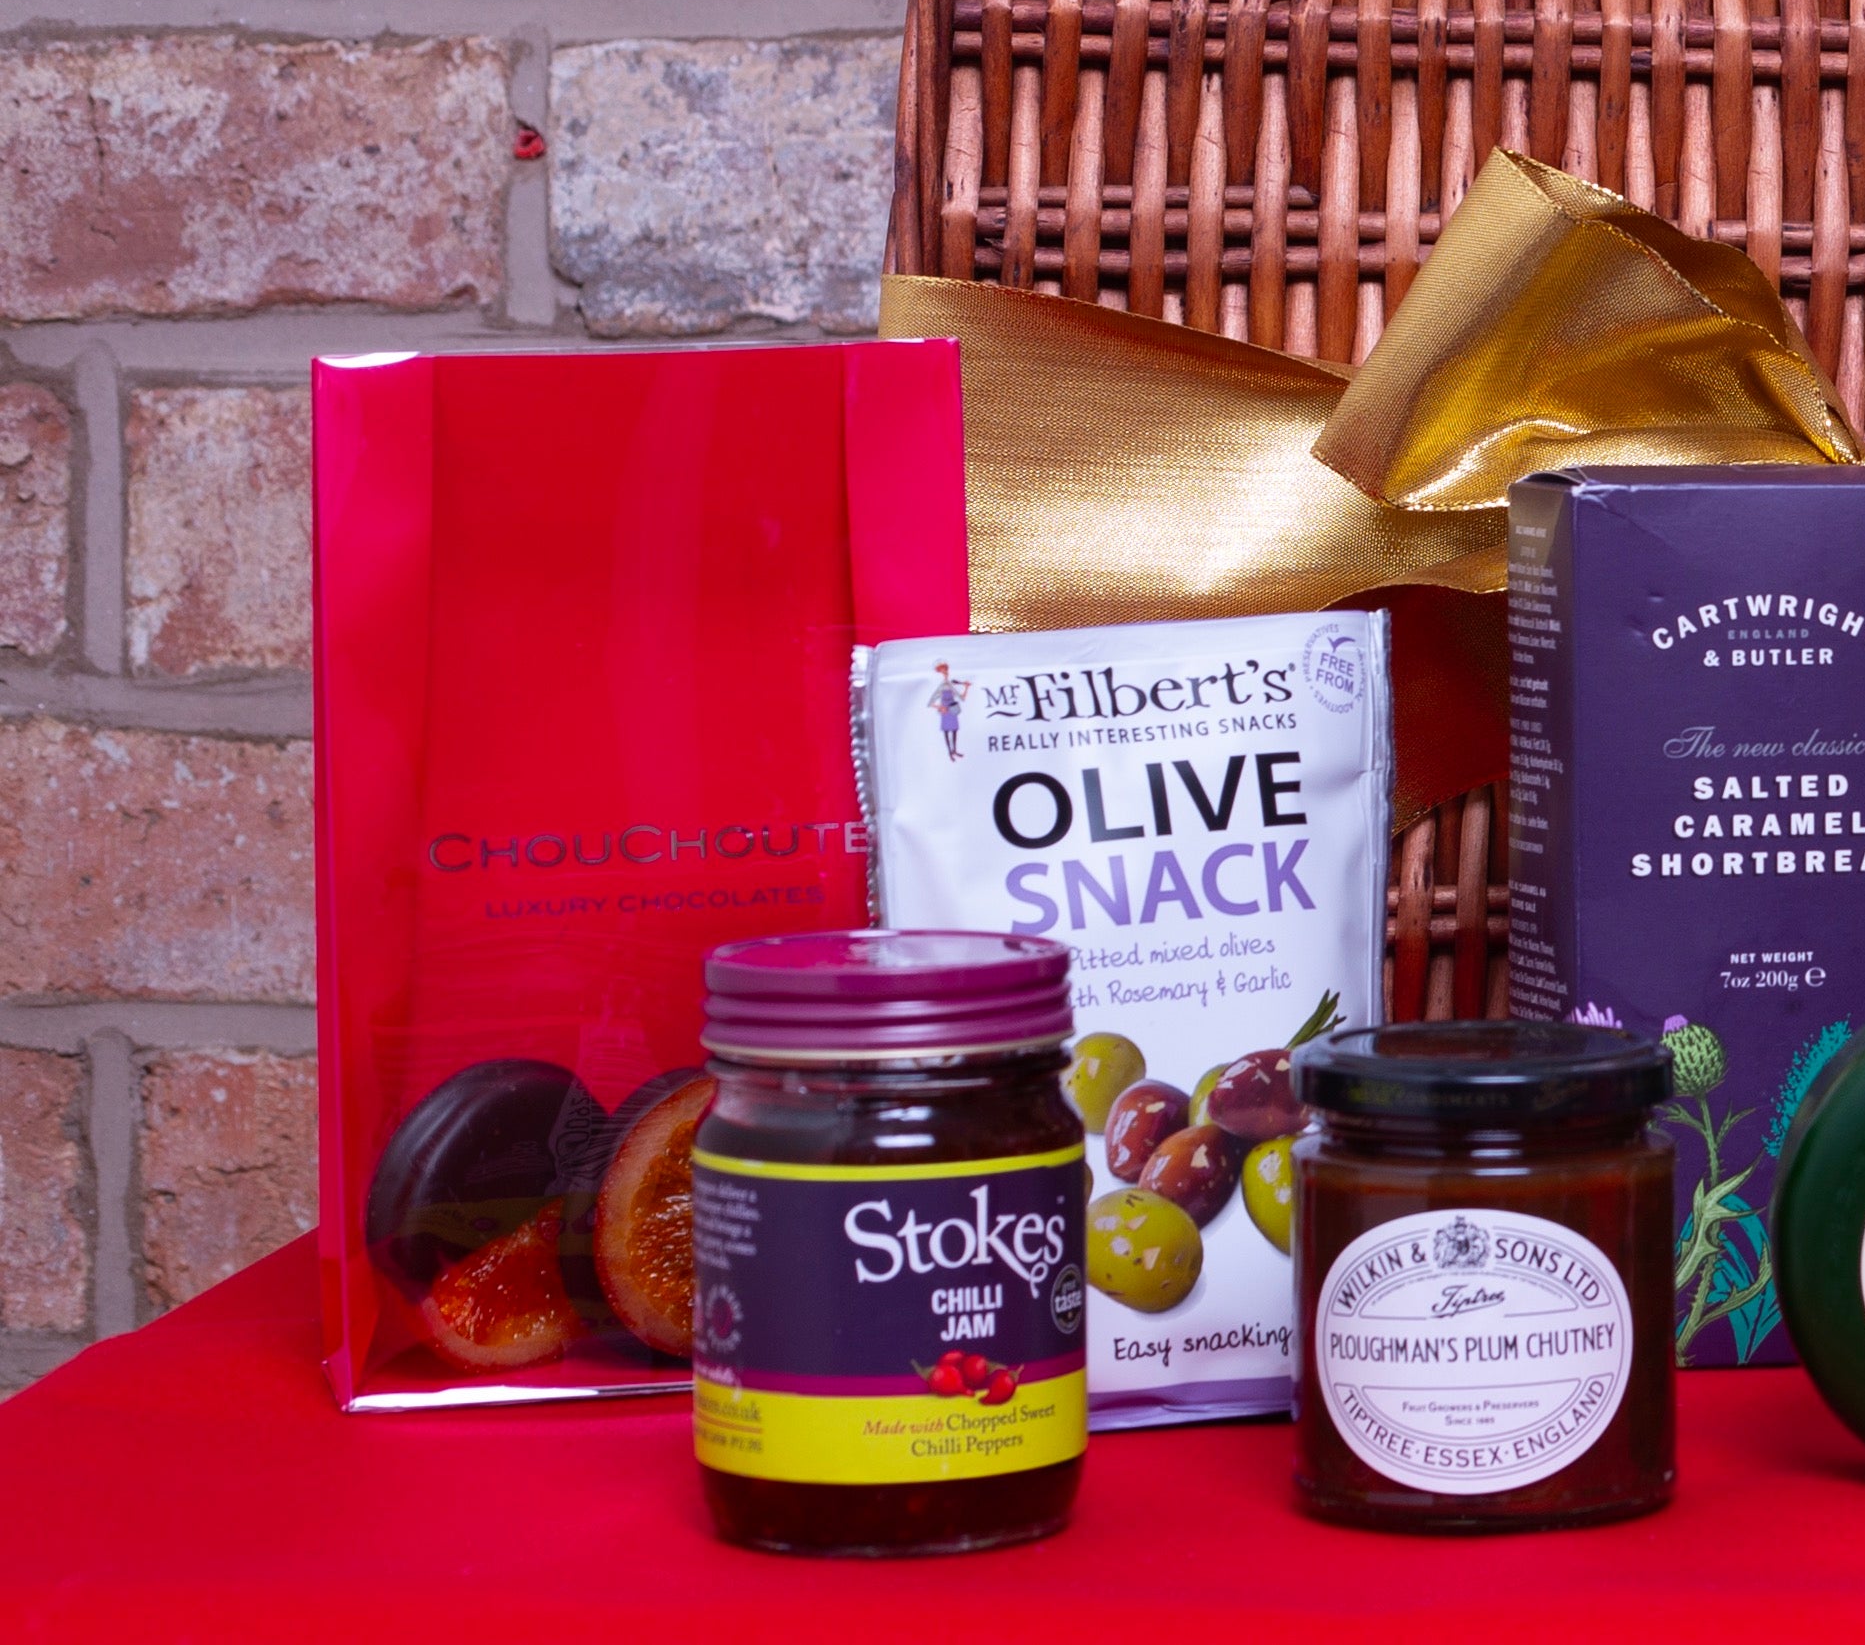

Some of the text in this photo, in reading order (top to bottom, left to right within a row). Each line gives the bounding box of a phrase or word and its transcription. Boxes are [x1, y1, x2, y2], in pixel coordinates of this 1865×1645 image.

[1727, 628, 1810, 640] ENGLAND
[1702, 647, 1835, 668] & BUTLER
[1016, 657, 1294, 723] Filbert's
[988, 712, 1298, 754] REALLY INTERESTING SNACKS
[1663, 725, 1726, 760] The
[1733, 740, 1785, 758] new
[992, 751, 1308, 850] OLIVE
[1692, 774, 1850, 802] SALTED
[1005, 838, 1317, 936] SNACK
[1149, 938, 1215, 965] mixed
[1218, 931, 1276, 960] olives
[1730, 951, 1814, 965] NET WEIGHT
[1109, 979, 1208, 1008] Rosemary
[1233, 964, 1293, 992] Garlic
[843, 1184, 1067, 1298] Stokes
[1337, 1243, 1404, 1311] WILKIN
[1410, 1242, 1427, 1264] &
[1495, 1237, 1563, 1276] SONS
[1562, 1261, 1602, 1303] LTD
[931, 1283, 1004, 1316] CHILLI
[939, 1310, 996, 1343] JAM
[1113, 1322, 1294, 1367] Easy snacking
[1330, 1321, 1616, 1364] PLOUGHMAN'S PLUM CHUTNEY
[863, 1402, 1057, 1437] Made with Chopped Sweet
[1342, 1378, 1605, 1469] TIPTREE ESSEX ENGLAND
[911, 1432, 1025, 1459] Chilli Peppers
